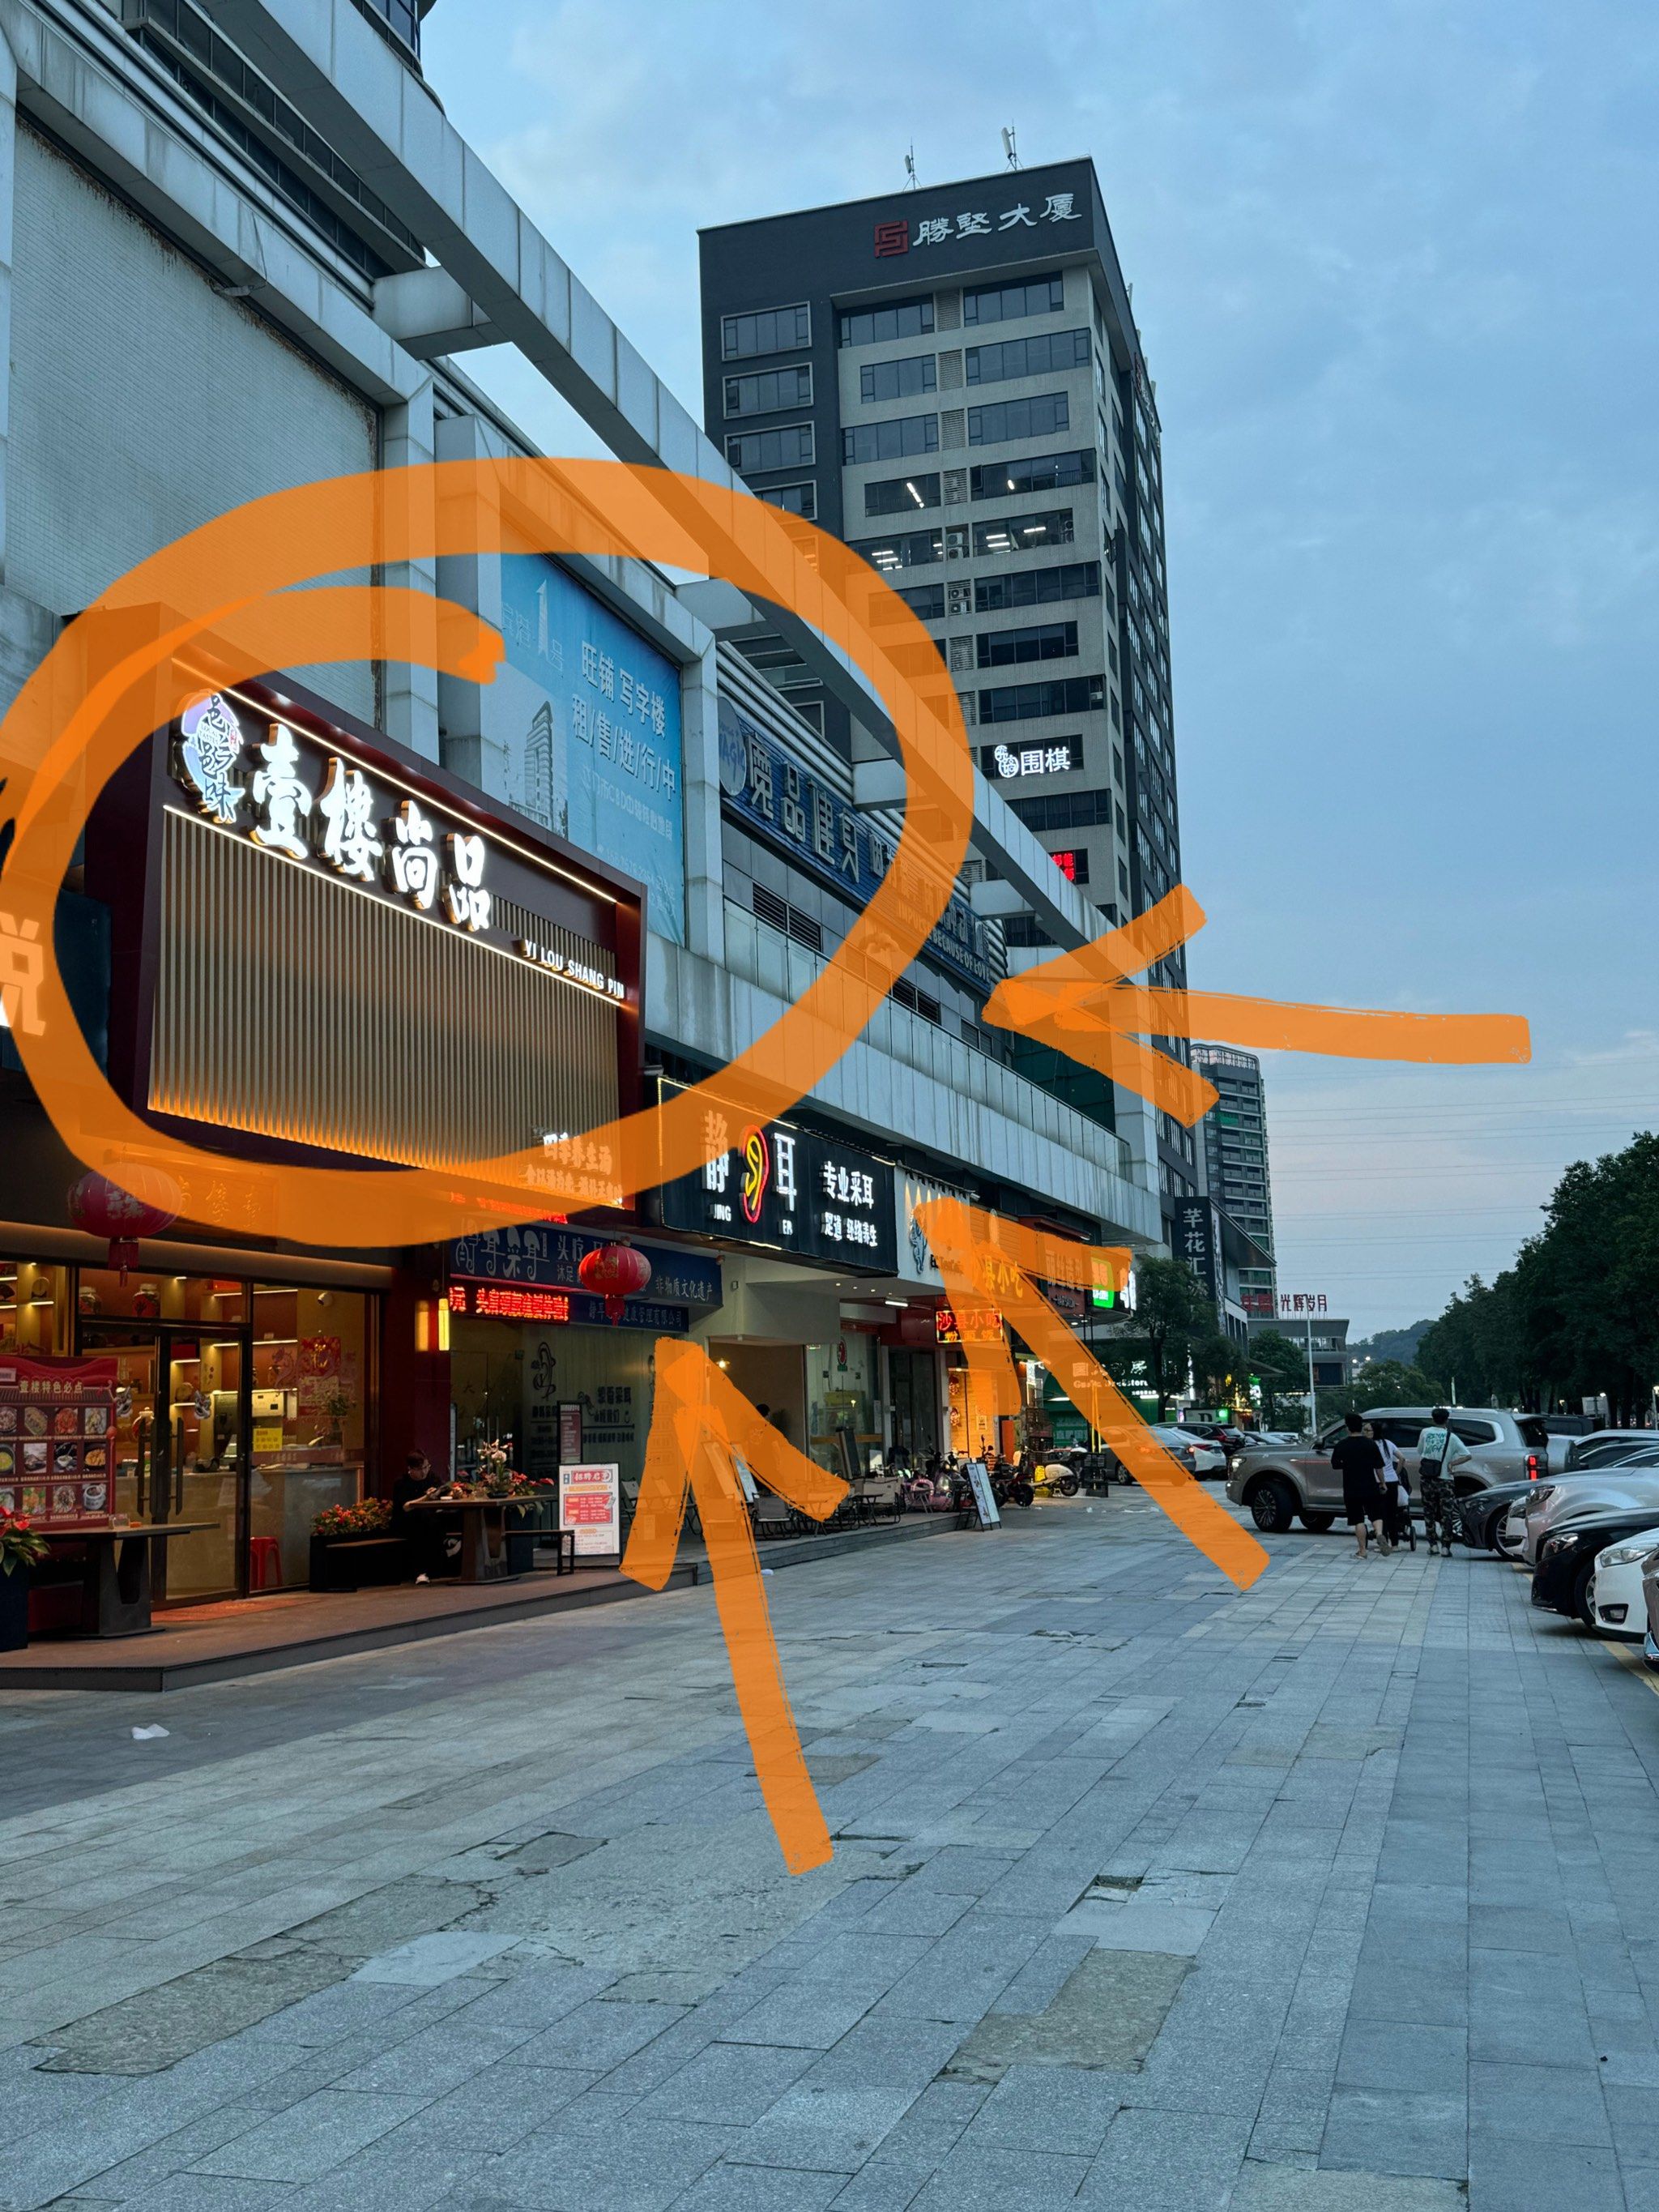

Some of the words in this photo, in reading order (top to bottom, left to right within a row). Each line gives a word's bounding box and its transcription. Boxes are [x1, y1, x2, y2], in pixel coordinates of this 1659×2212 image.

[581, 640, 615, 703] 旺铺
[620, 669, 666, 739] 写字楼
[1020, 745, 1071, 776] 围棋
[524, 939, 537, 960] YI
[540, 946, 564, 971] LOU
[567, 959, 604, 989] SHANG
[608, 978, 625, 999] PIN
[822, 1160, 875, 1210] 专业采耳
[655, 1275, 713, 1303] 非物质文化遗产
[1281, 1293, 1328, 1312] 光辉岁月
[19, 1380, 84, 1394] 壹楼特色必点
